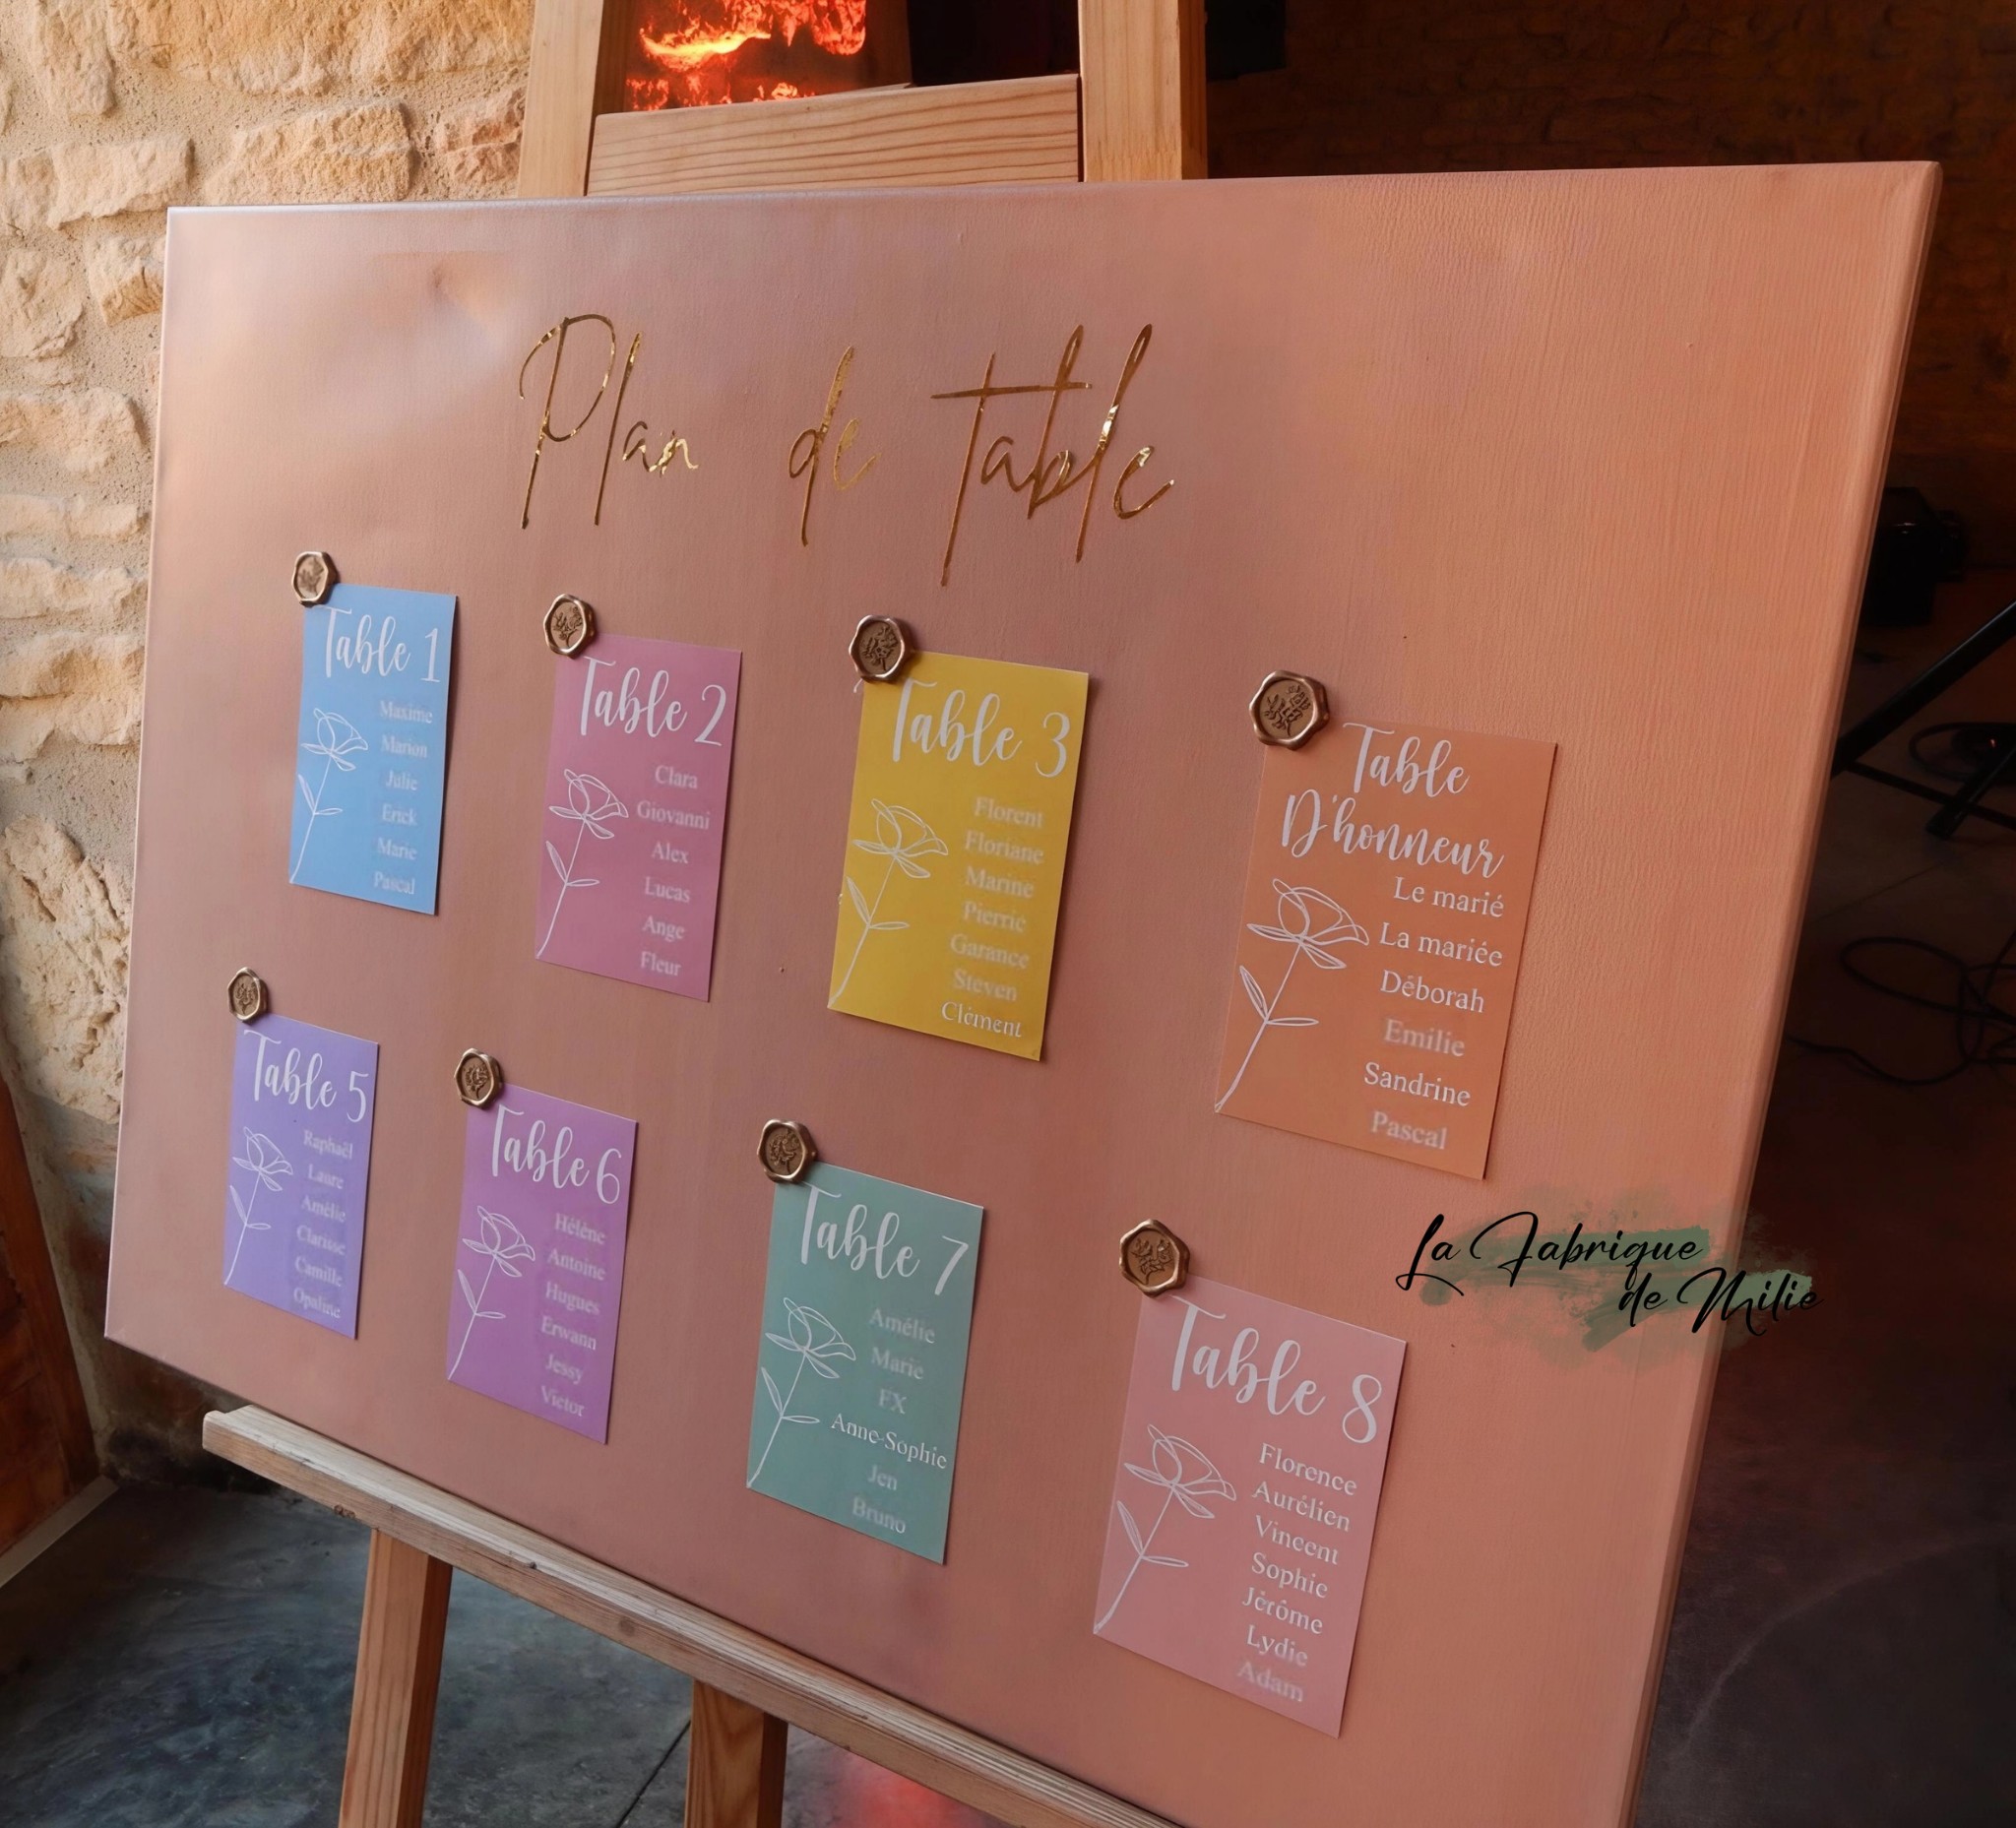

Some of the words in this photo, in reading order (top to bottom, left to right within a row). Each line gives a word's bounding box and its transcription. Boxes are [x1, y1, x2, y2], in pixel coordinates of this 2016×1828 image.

[519, 313, 699, 530] Plan
[788, 346, 881, 547] de
[315, 604, 410, 677] Table
[420, 628, 441, 682] 1
[380, 700, 433, 725] Maxime
[580, 656, 687, 737] Table
[694, 684, 727, 747] 2
[381, 734, 427, 759] Marion
[891, 678, 1023, 767] Table
[1035, 712, 1071, 778] 3
[655, 765, 698, 789] Clara
[1343, 722, 1470, 797] Table
[637, 800, 710, 830] Giovanni
[974, 796, 1043, 828] Florent
[377, 838, 417, 861] Marie
[965, 830, 1044, 864] Floriane
[1282, 788, 1505, 878] D'honneur
[652, 841, 689, 864] Alex
[644, 877, 691, 904] Lucas
[965, 865, 1035, 899] Marine
[1393, 876, 1425, 904] Le
[1433, 890, 1505, 917] marié
[642, 915, 685, 941] Ange
[1380, 922, 1409, 949] La
[1418, 936, 1503, 967] mariée
[641, 951, 681, 977] Fleur
[950, 934, 1030, 969] Garance
[953, 971, 1018, 1002] Steven
[1380, 970, 1485, 1014] Déborah
[941, 1001, 1023, 1039] Clément
[1384, 1018, 1466, 1057] Emilie
[244, 1029, 337, 1110] Table
[346, 1071, 369, 1123] 5
[1364, 1061, 1472, 1107] Sandrine
[1370, 1110, 1446, 1151] Pascal
[492, 1103, 590, 1188] Table
[597, 1148, 622, 1204] 6
[555, 1212, 606, 1245] Hélène
[799, 1181, 920, 1280] Table
[934, 1235, 970, 1296] 7
[547, 1249, 606, 1281] Antoine
[545, 1282, 599, 1315] Hugues
[540, 1316, 598, 1351] Erwann
[869, 1307, 937, 1344] Amélie
[545, 1354, 583, 1385] Jessy
[871, 1347, 924, 1380] Marie
[1168, 1294, 1326, 1416] Table
[1342, 1374, 1382, 1444] 8
[540, 1386, 584, 1418] Victor
[878, 1389, 907, 1415] FX
[831, 1413, 948, 1470] Anne-Sophie
[867, 1465, 899, 1491] Jen
[1259, 1443, 1357, 1496] Florence
[852, 1496, 907, 1535] Bruno
[1251, 1481, 1350, 1533] Aurélien
[1255, 1515, 1339, 1566] Vincent
[1251, 1552, 1328, 1599] Sophie
[1242, 1587, 1323, 1636] Jérôme
[1246, 1625, 1308, 1667] Lydie
[1237, 1660, 1304, 1704] Adam
